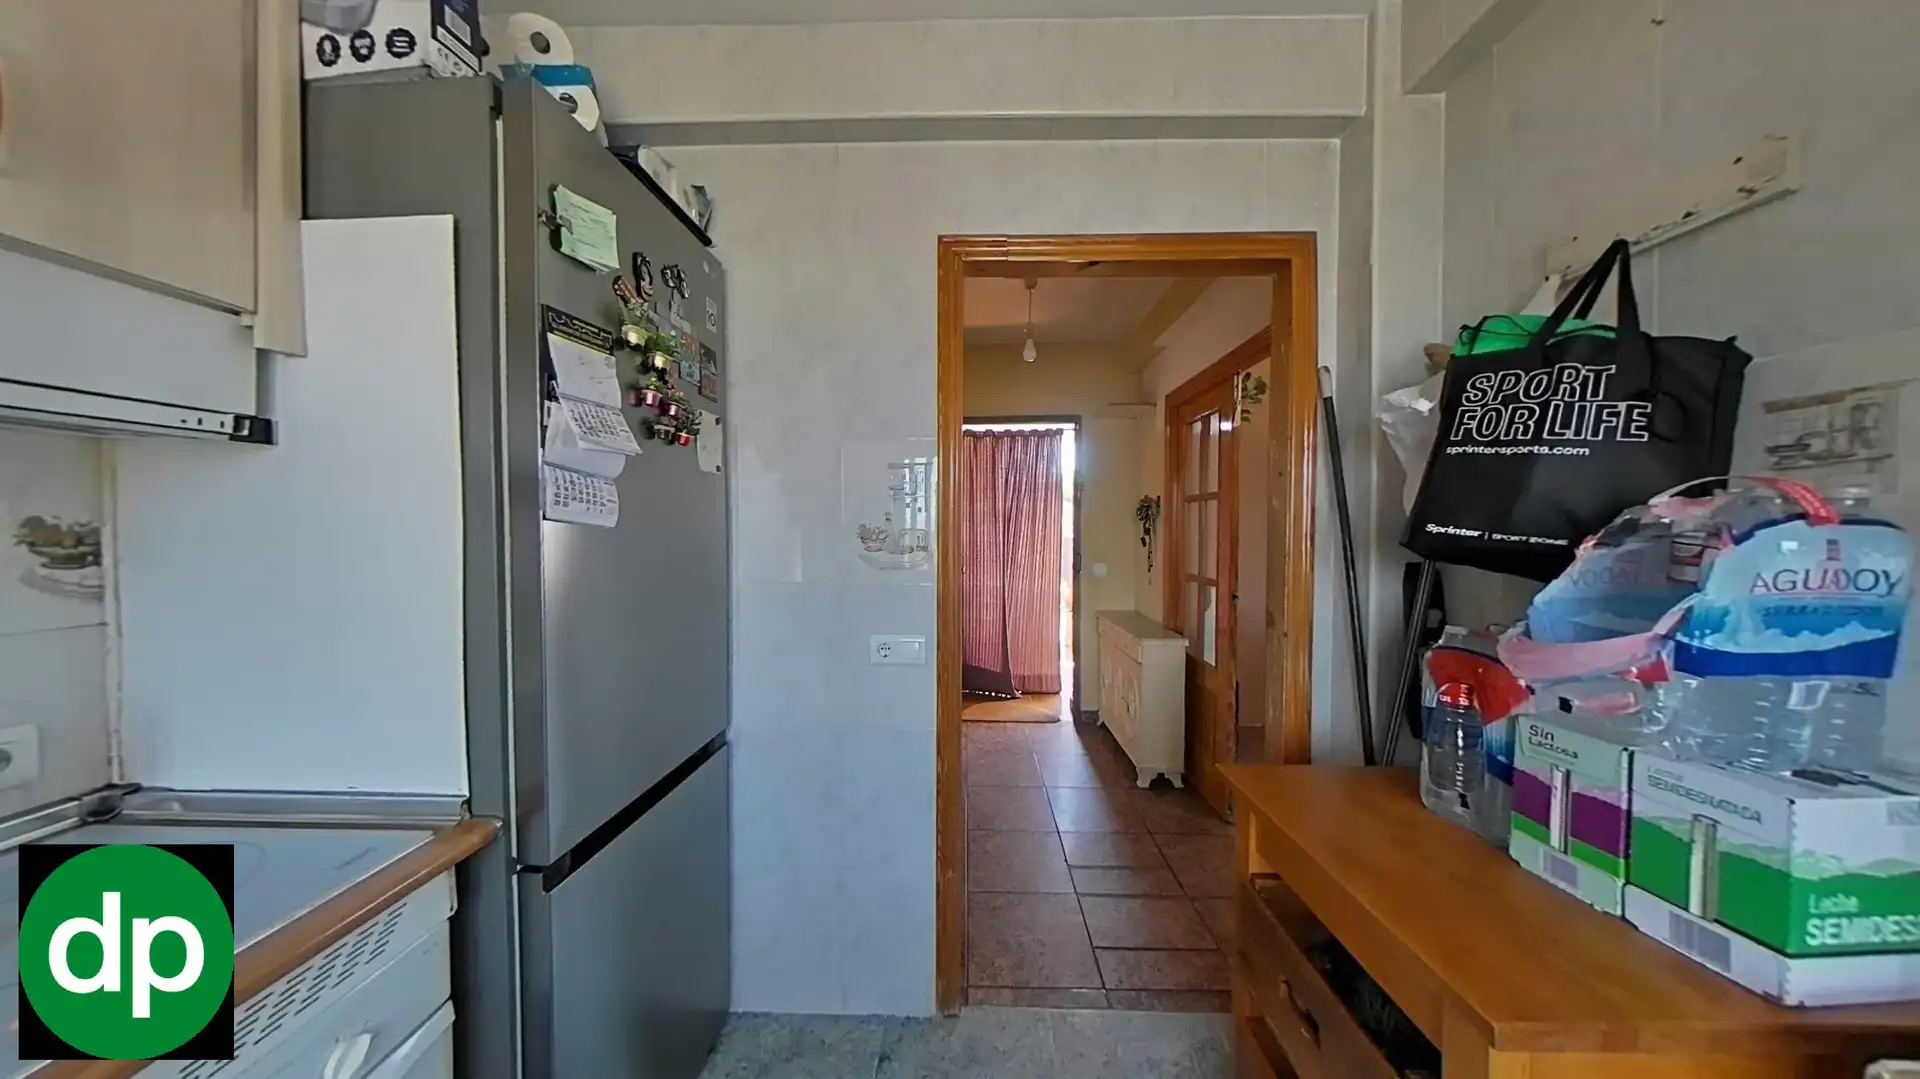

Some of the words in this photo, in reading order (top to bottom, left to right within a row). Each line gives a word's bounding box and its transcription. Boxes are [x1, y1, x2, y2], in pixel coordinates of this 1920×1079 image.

[1463, 363, 1616, 406] SPORT
[1450, 404, 1540, 441] FOR
[1543, 401, 1652, 442] LIFE
[1446, 444, 1590, 456] sprintersports.com
[1425, 523, 1482, 537] Sprinter
[1528, 724, 1555, 742] Sin
